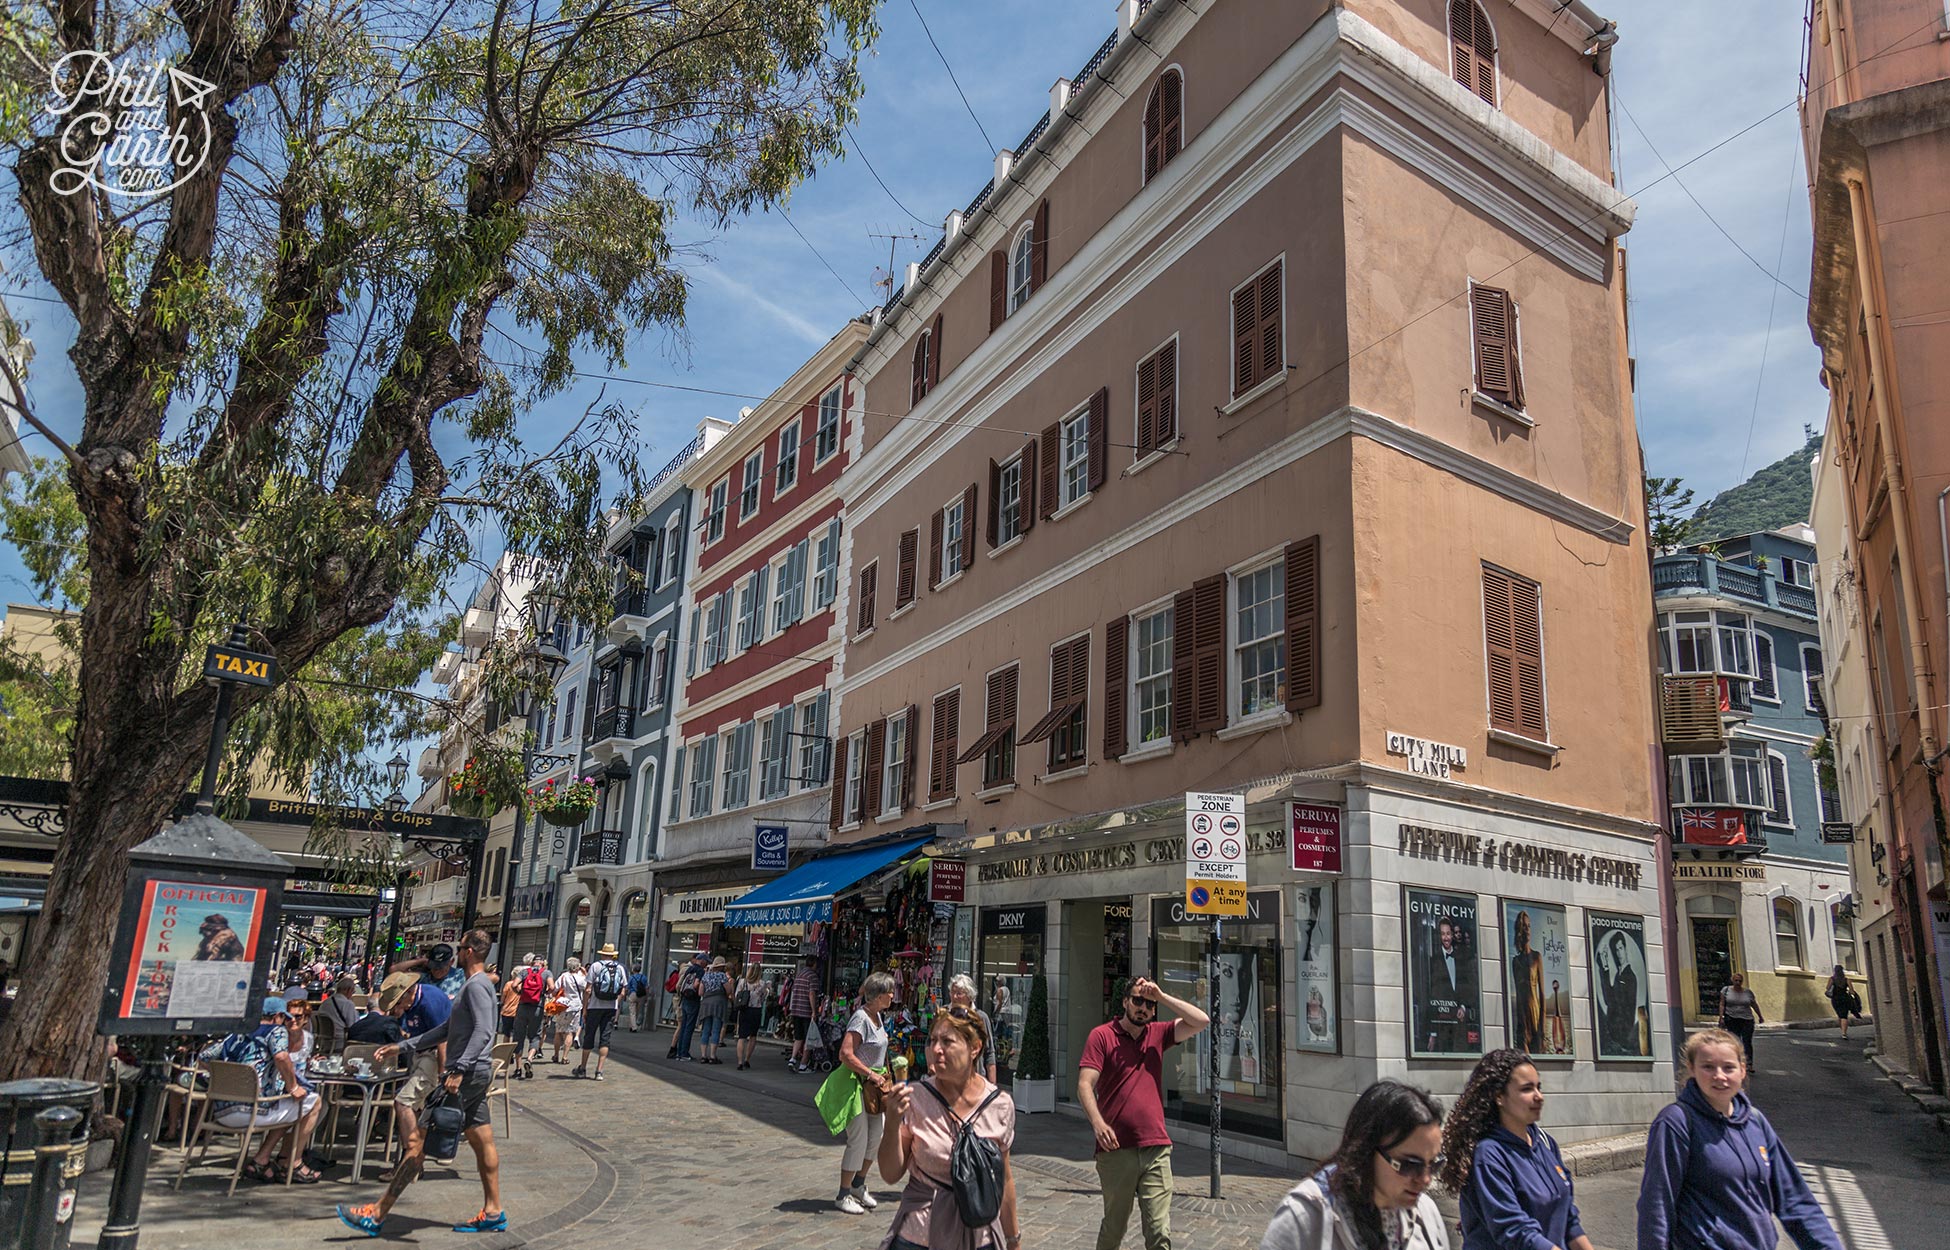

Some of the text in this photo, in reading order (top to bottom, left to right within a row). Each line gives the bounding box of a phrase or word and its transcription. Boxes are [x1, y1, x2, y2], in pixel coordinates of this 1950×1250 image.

[215, 653, 268, 678] TAXI
[1391, 735, 1465, 765] CITY MILL
[1410, 757, 1448, 778] LANE
[1197, 794, 1234, 802] PEDESTRIAN
[1201, 801, 1231, 811] ZONE
[373, 807, 384, 821] &
[391, 812, 433, 828] Chips
[1295, 808, 1338, 823] SERUYA
[1299, 826, 1334, 835] PERFUMES
[1298, 843, 1336, 853] COSMETICS
[1399, 824, 1481, 854] PERFUME
[1485, 838, 1497, 856] &
[1500, 841, 1586, 871] COSMETICS
[757, 858, 786, 866] Souvenirs
[933, 862, 964, 872] SERUYA
[1035, 854, 1047, 876] &
[1199, 863, 1234, 872] EXCEPT
[1194, 871, 1213, 879] Permit
[1679, 865, 1766, 879] HEALTH STORE
[161, 887, 248, 906] OFFICIAL
[1213, 887, 1245, 897] At any
[1219, 895, 1240, 905] time
[1104, 905, 1133, 918] FORD
[1410, 900, 1475, 919] GIVENCHY
[999, 912, 1025, 926] DKNY
[1591, 917, 1642, 931] paco rabanne
[145, 905, 178, 1010] ROCK TOUR
